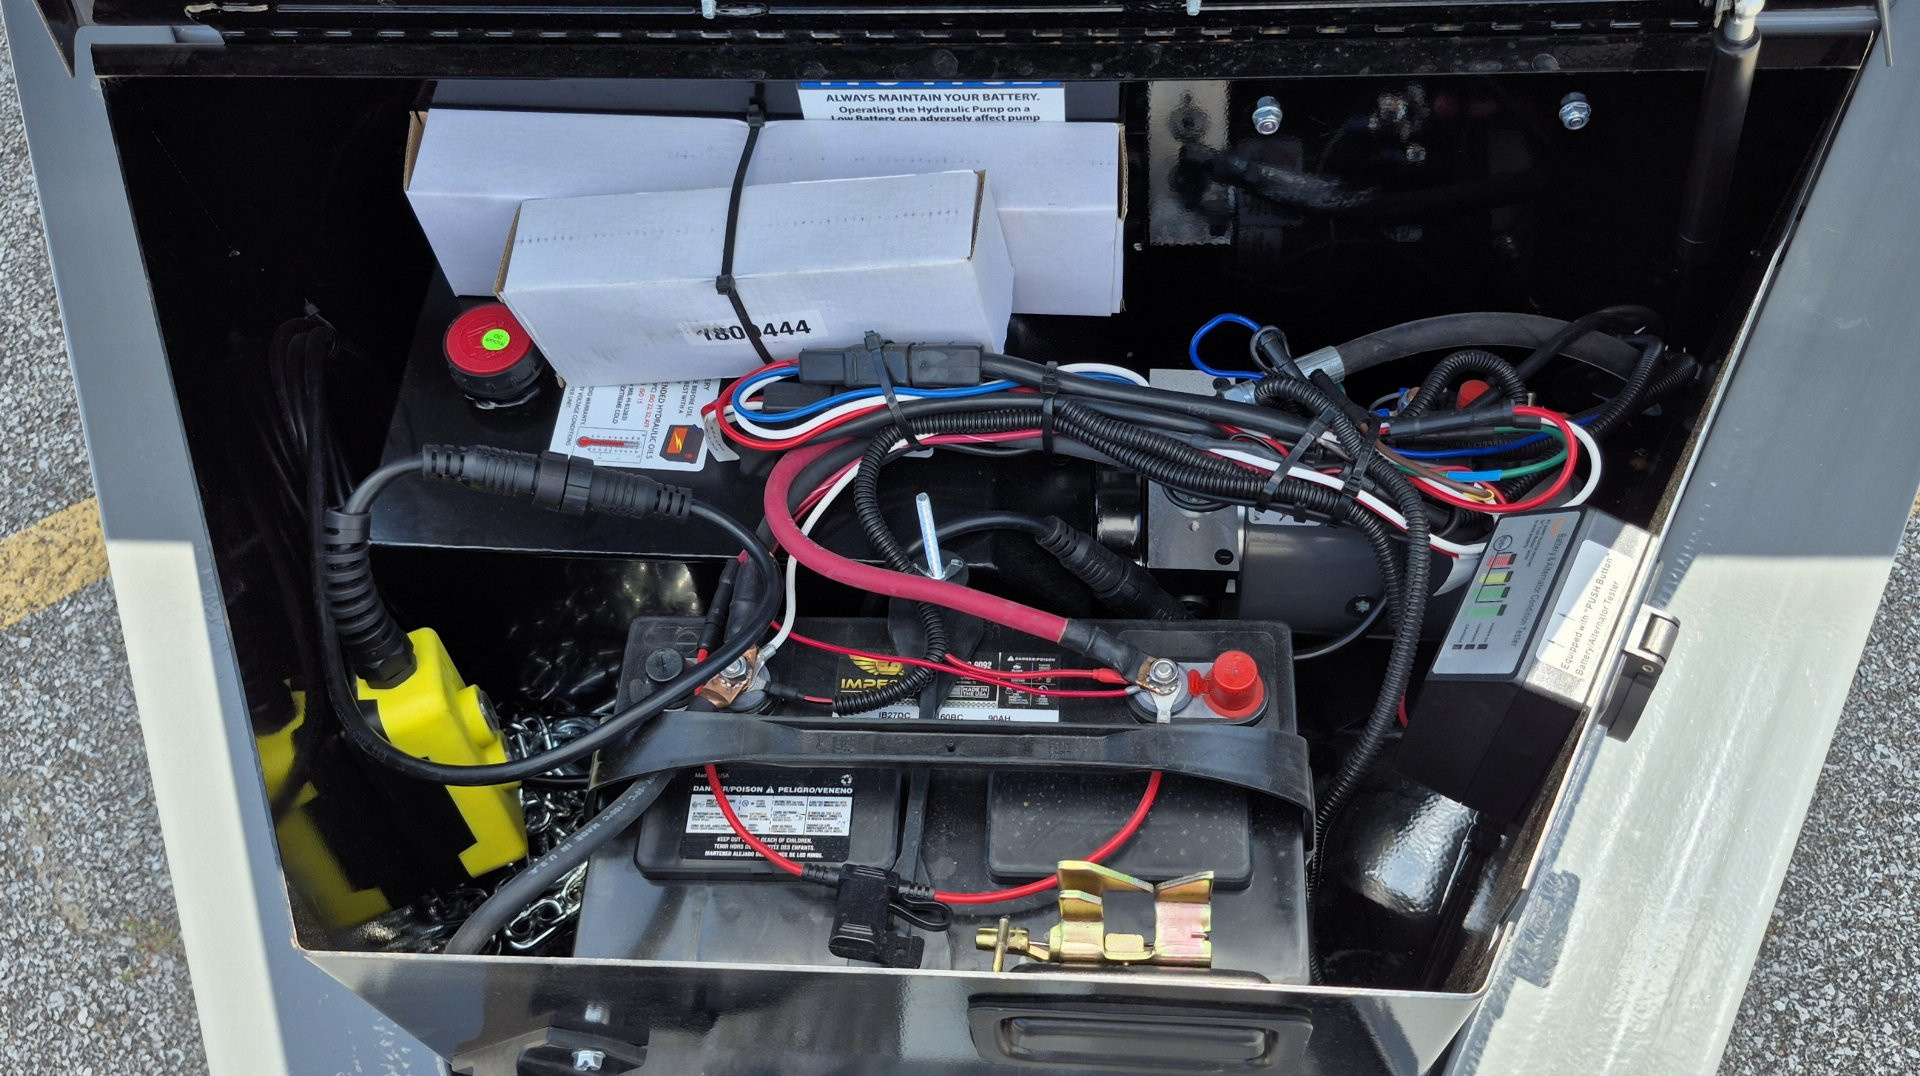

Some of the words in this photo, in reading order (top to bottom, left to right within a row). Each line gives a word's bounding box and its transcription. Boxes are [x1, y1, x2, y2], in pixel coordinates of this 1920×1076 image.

[826, 93, 876, 102] ALWAYS
[878, 93, 942, 102] MAINTAIN
[943, 93, 979, 102] YOUR
[982, 93, 1040, 102] BATTERY.
[839, 106, 894, 116] Operating
[917, 105, 969, 114] Hydraulic
[972, 106, 1005, 115] Pump
[975, 114, 1005, 122] affect
[573, 392, 584, 413] VOLTAGE
[612, 409, 620, 424] COLD
[650, 404, 664, 443] HYDRAULIC
[565, 414, 578, 446] CONDITIONS
[645, 445, 656, 459] OILS
[1549, 533, 1566, 556] Battery
[1511, 626, 1526, 647] Tester
[1575, 606, 1609, 676] Battery/Alternator
[1603, 580, 1620, 605] Tester
[1561, 632, 1583, 670] Equipped
[1579, 615, 1588, 631] with
[693, 785, 763, 793] DANR/POISON
[777, 786, 853, 794] PELIGRO/VENENO
[574, 822, 601, 842] MADE
